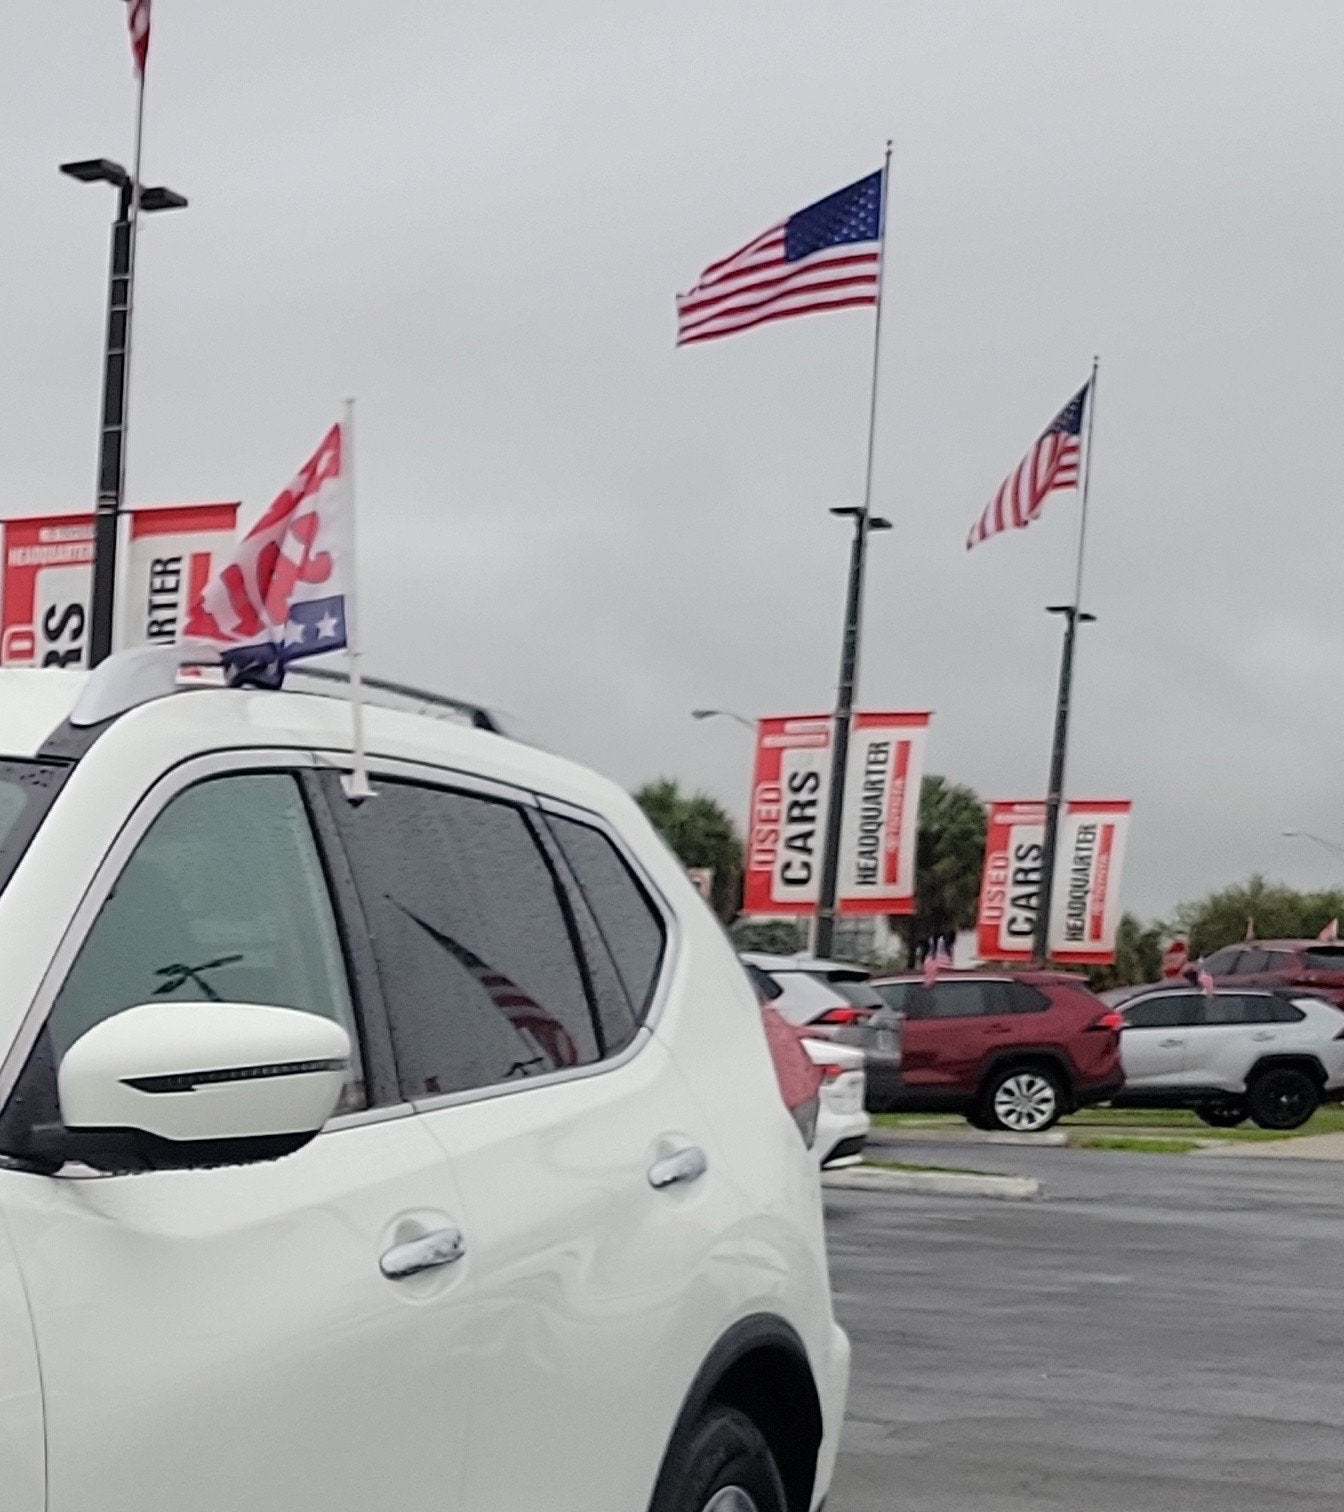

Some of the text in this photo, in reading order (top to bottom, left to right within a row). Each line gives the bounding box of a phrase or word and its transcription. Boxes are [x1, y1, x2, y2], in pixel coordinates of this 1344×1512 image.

[753, 785, 781, 866] USED
[781, 771, 820, 886] CARS
[855, 741, 890, 886] HEADQUARTER
[985, 856, 1009, 921] USED
[1007, 843, 1042, 937] CARS
[1063, 823, 1097, 942] HEADQUARTER
